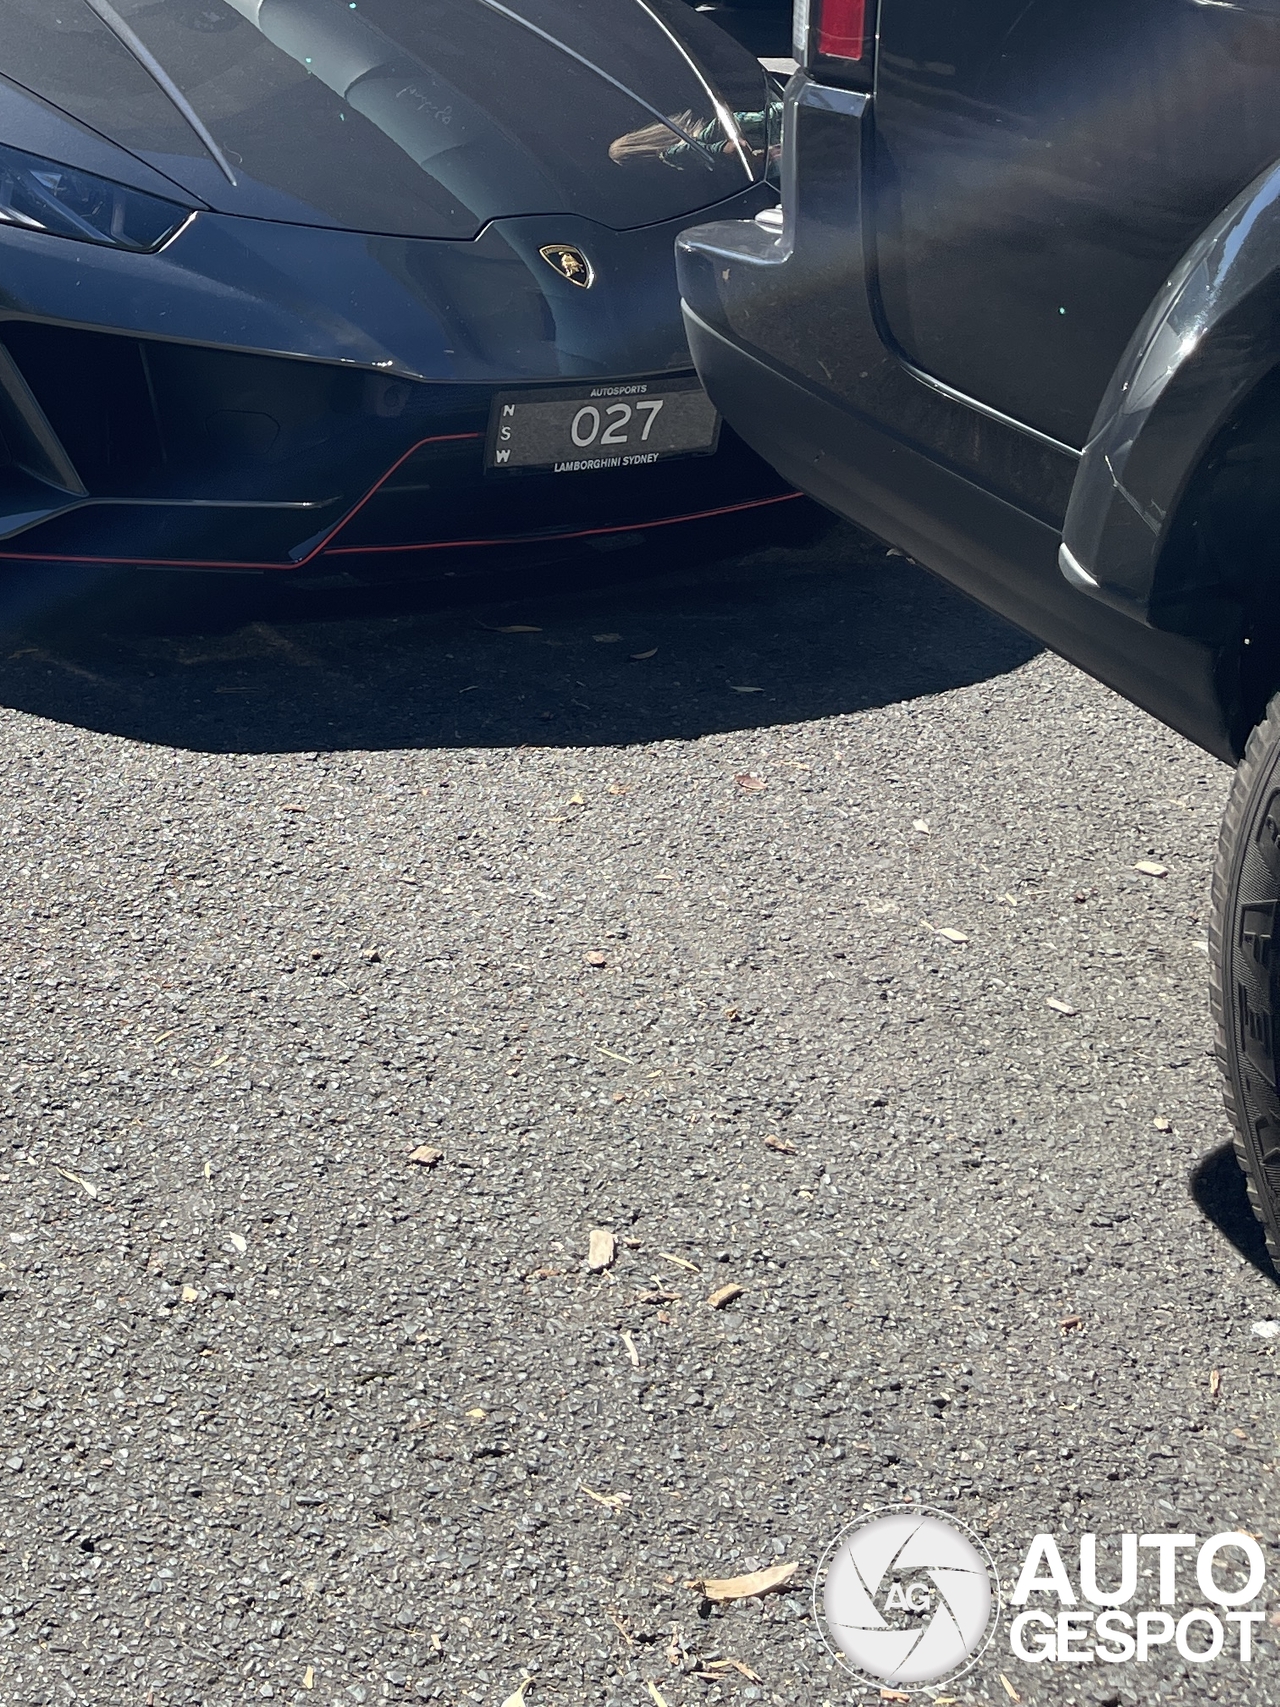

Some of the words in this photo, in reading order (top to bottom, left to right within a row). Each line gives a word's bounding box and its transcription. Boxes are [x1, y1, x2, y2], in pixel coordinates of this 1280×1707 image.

[590, 384, 647, 398] AUTOSPORTS
[570, 399, 664, 448] 027
[553, 456, 621, 473] LAMBORGHINI
[621, 452, 660, 466] SYDNEY
